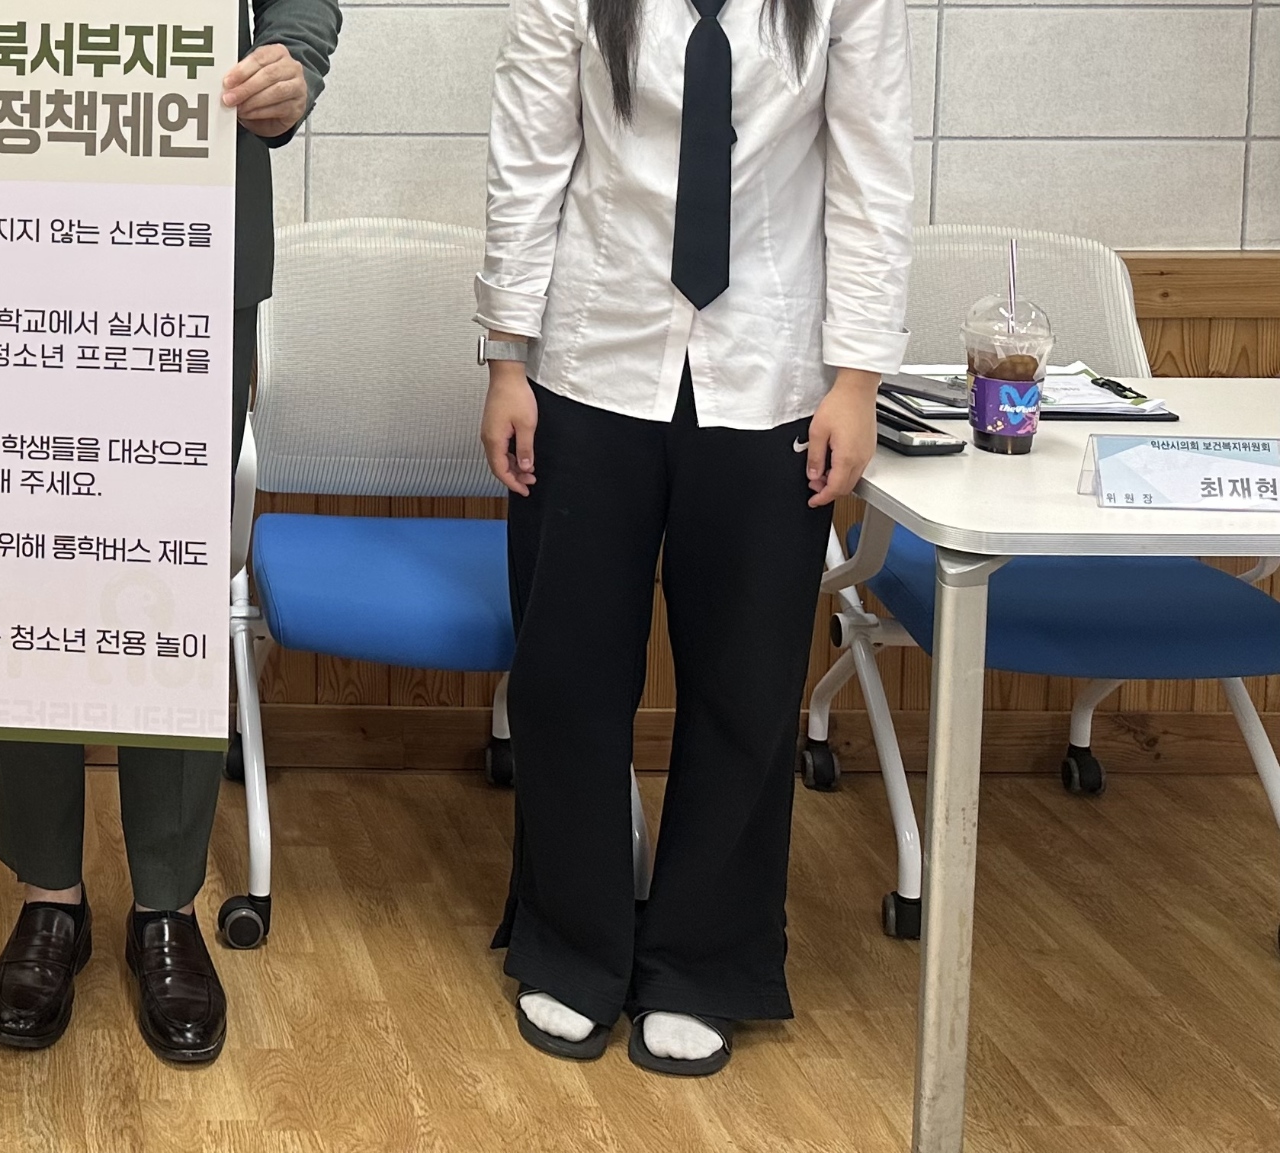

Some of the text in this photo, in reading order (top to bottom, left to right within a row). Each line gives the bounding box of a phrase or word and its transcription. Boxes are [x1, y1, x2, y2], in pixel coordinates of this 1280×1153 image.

[50, 218, 100, 245] 않는
[109, 220, 213, 248] 신호등을
[108, 311, 211, 339] 실시하고
[75, 345, 211, 374] 프로그램을
[1, 433, 101, 463] 학생들을
[108, 438, 209, 467] 대상으로
[1150, 440, 1271, 453] 익산시의회 보건복지위원회
[20, 470, 102, 497] 주세요.
[52, 534, 152, 563] 통학버스
[158, 539, 208, 566] 제도
[10, 624, 86, 654] 청소년
[96, 629, 147, 656] 전용
[155, 631, 207, 660] 놀이
